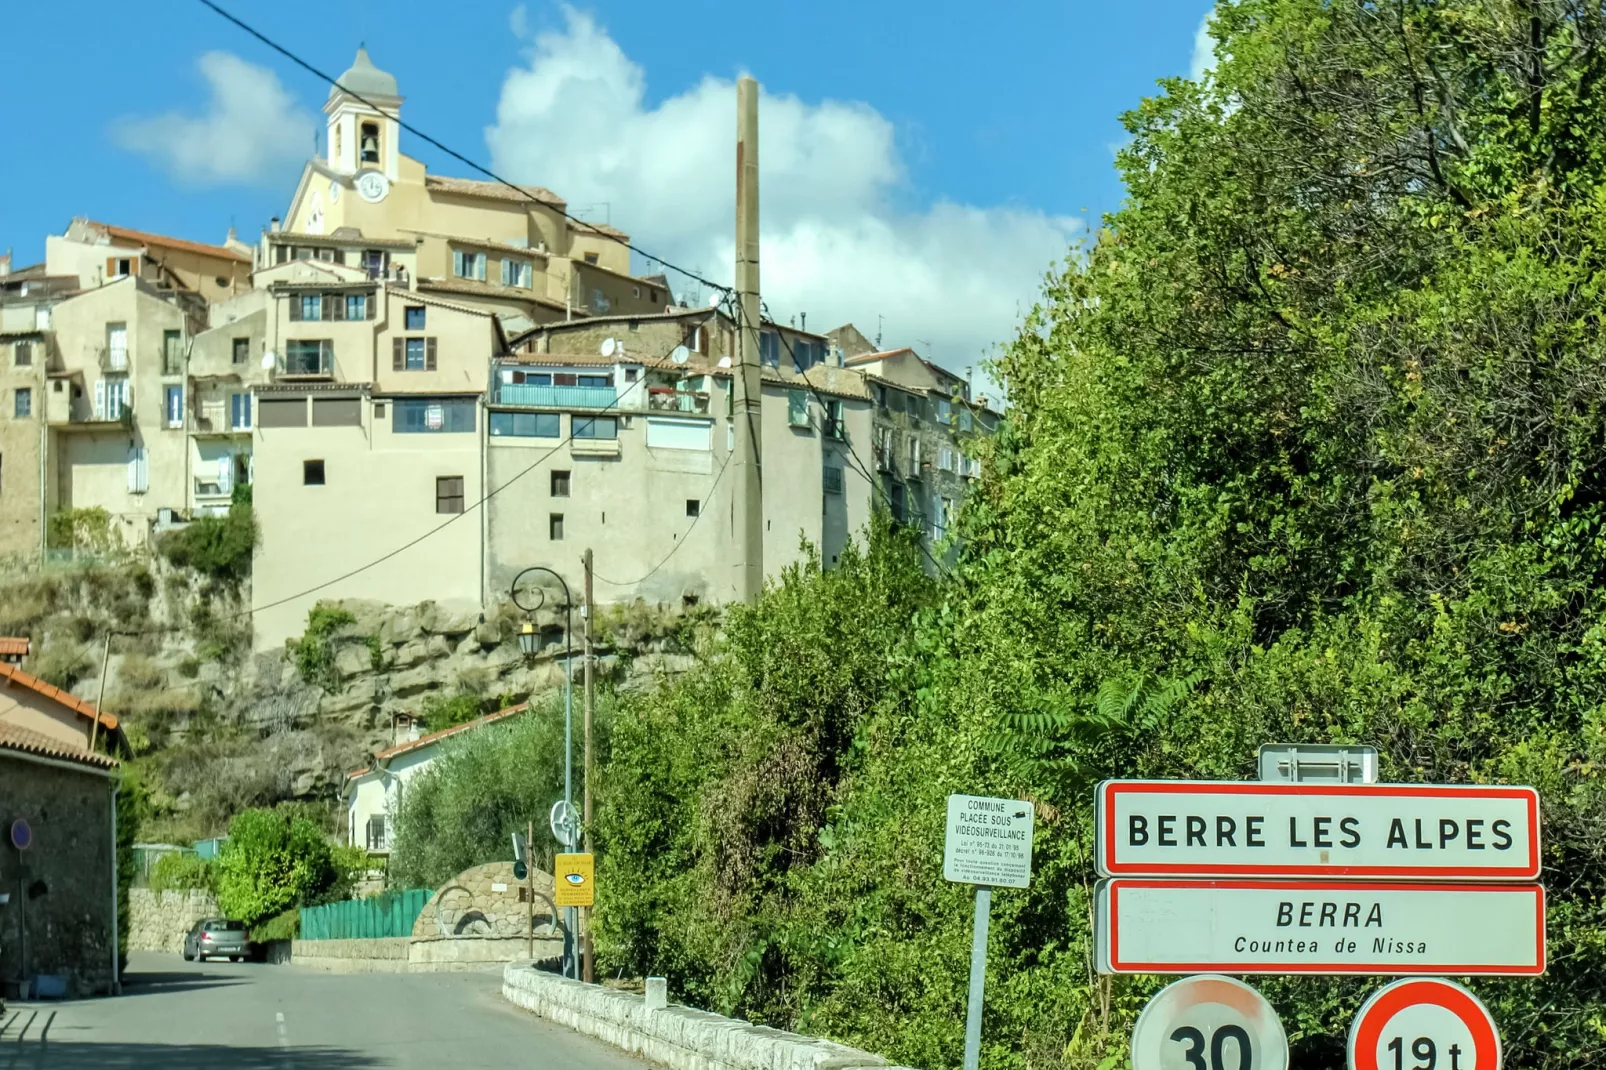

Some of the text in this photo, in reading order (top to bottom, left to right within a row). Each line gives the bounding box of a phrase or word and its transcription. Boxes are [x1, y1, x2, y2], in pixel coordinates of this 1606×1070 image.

[968, 800, 1005, 812] COMMUNE
[960, 812, 1011, 826] PLACÉE SOUS
[1130, 816, 1512, 850] BERRE LES ALPES
[1277, 903, 1381, 927] BERRA
[1235, 937, 1425, 953] Countea de Nissa
[1170, 1025, 1251, 1070] 30
